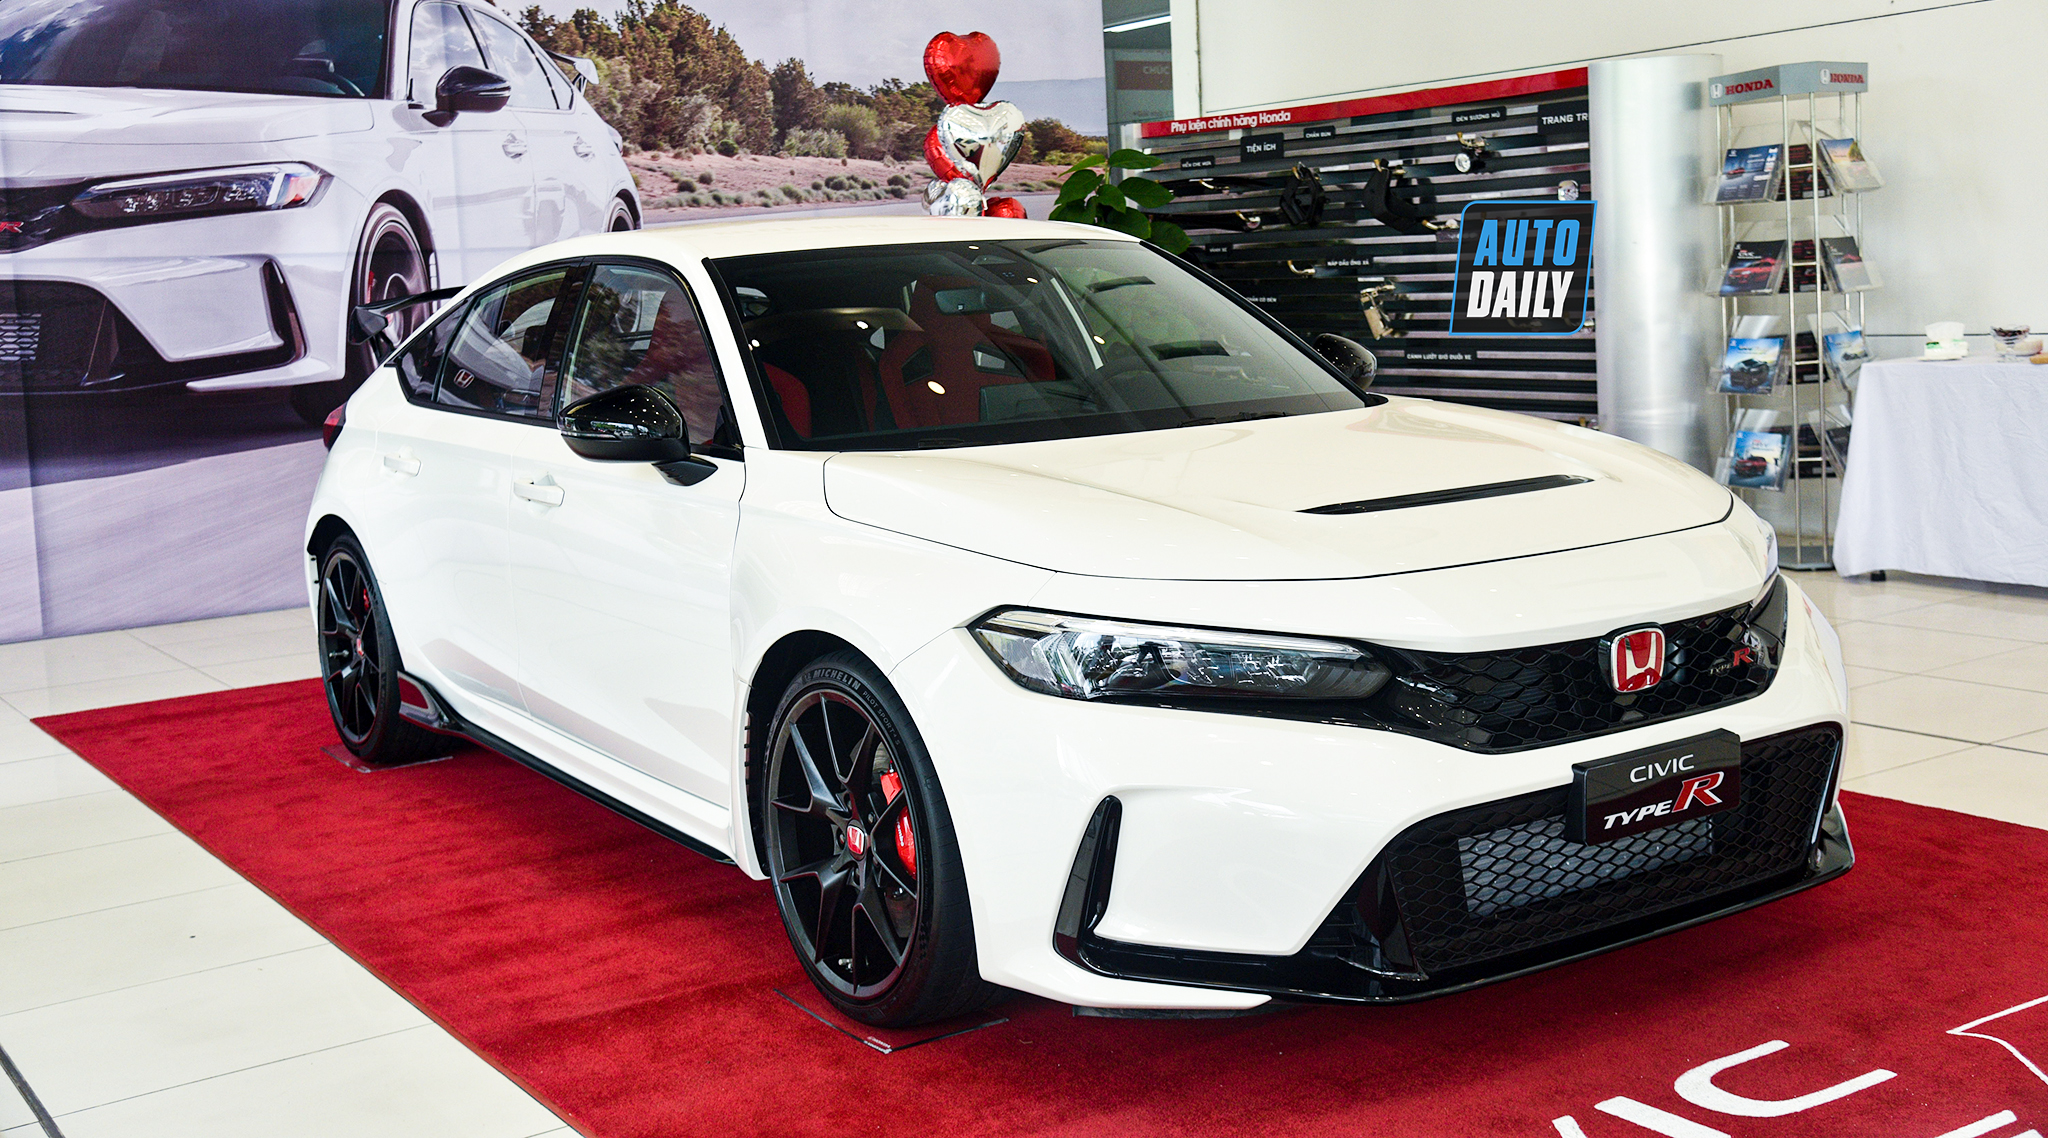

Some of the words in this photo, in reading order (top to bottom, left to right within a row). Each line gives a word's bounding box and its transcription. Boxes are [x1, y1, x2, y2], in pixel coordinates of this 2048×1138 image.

[1725, 78, 1774, 95] HONDA
[1830, 73, 1865, 84] HONDA
[1171, 121, 1187, 133] Phụ
[1188, 119, 1207, 132] kiện
[1207, 116, 1232, 129] chính
[1259, 111, 1291, 124] Honda
[1542, 114, 1573, 125] TRANG
[1246, 144, 1262, 154] TIỆN
[1263, 143, 1276, 152] ÍCH
[1733, 647, 1753, 667] R
[813, 669, 861, 691] MICHELIN
[862, 690, 878, 709] PILOT
[877, 709, 896, 735] SPORT
[1630, 754, 1695, 783] CIVIC
[1604, 799, 1673, 830] TYPE
[1672, 771, 1725, 813] R
